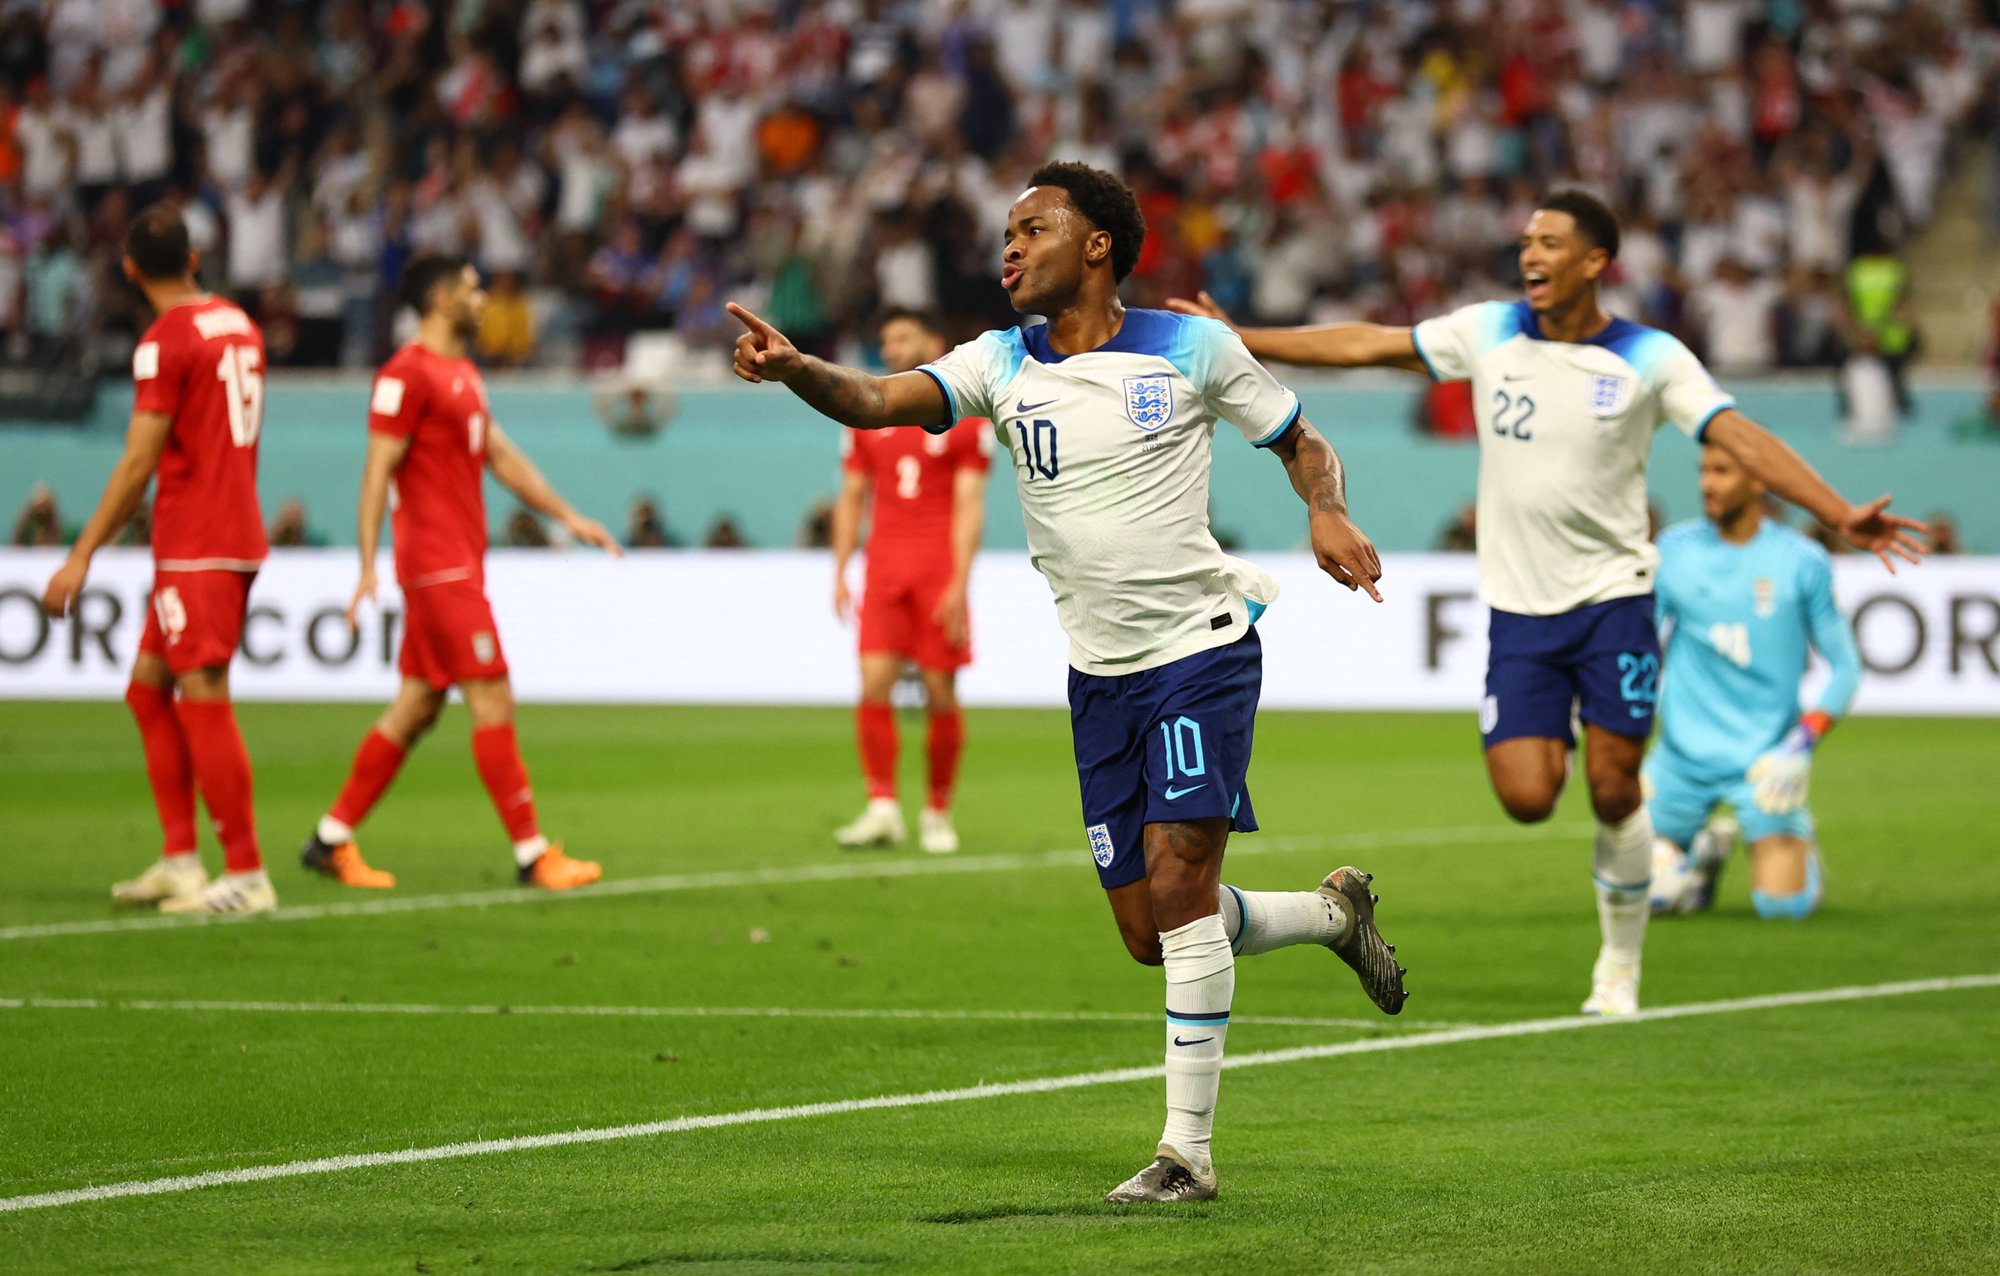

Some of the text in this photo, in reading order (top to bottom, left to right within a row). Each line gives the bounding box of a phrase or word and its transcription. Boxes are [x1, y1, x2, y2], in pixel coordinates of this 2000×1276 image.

[216, 344, 264, 448] 15
[1492, 389, 1535, 442] 22
[1015, 419, 1059, 481] 10
[1617, 652, 1659, 702] 22
[1160, 715, 1206, 780] 10
